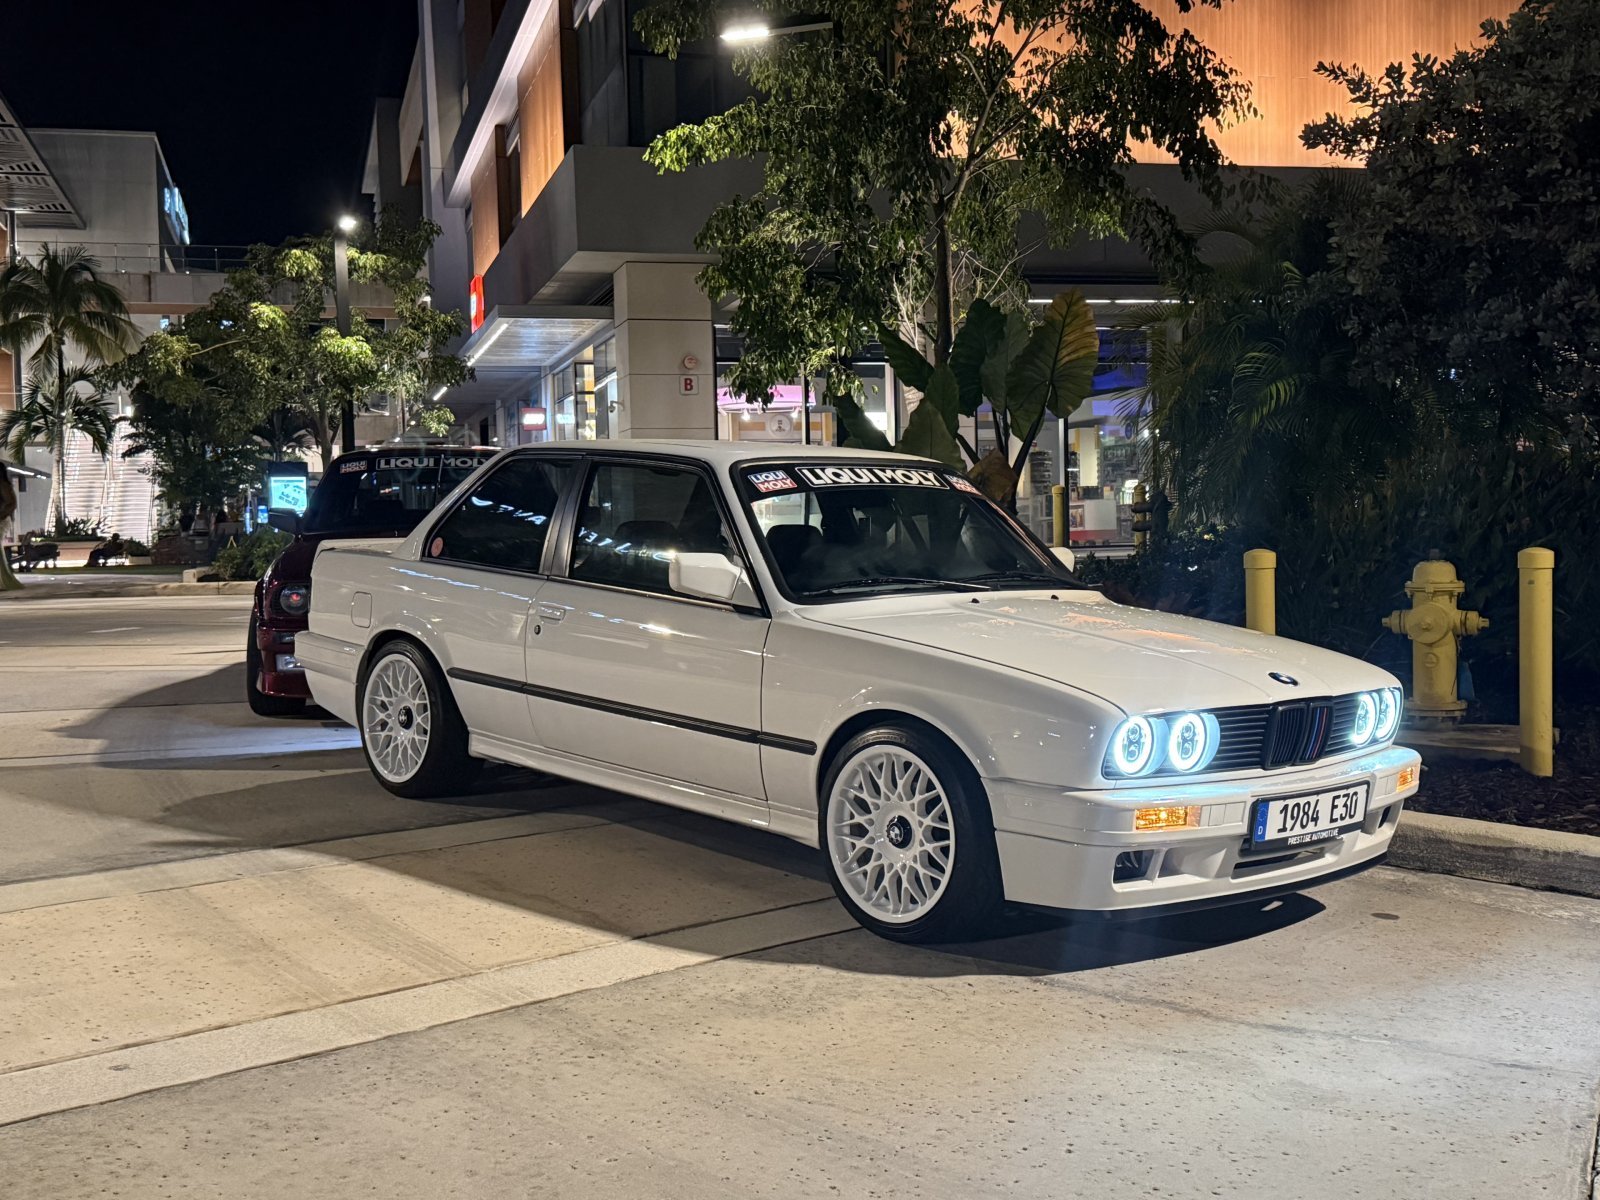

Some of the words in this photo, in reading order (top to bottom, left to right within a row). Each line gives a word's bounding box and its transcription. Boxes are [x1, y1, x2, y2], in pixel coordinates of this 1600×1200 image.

[684, 377, 694, 392] B
[380, 457, 435, 469] LIQUI
[750, 471, 788, 483] LIQUI
[801, 467, 880, 485] LIQUI
[872, 468, 941, 487] MOLY
[757, 479, 793, 492] MOLY
[1258, 826, 1264, 835] D
[1277, 798, 1320, 833] 1984
[1329, 791, 1359, 824] E30
[1287, 833, 1312, 846] PRESTIGE
[1312, 828, 1339, 841] AUTOMOTIVE
